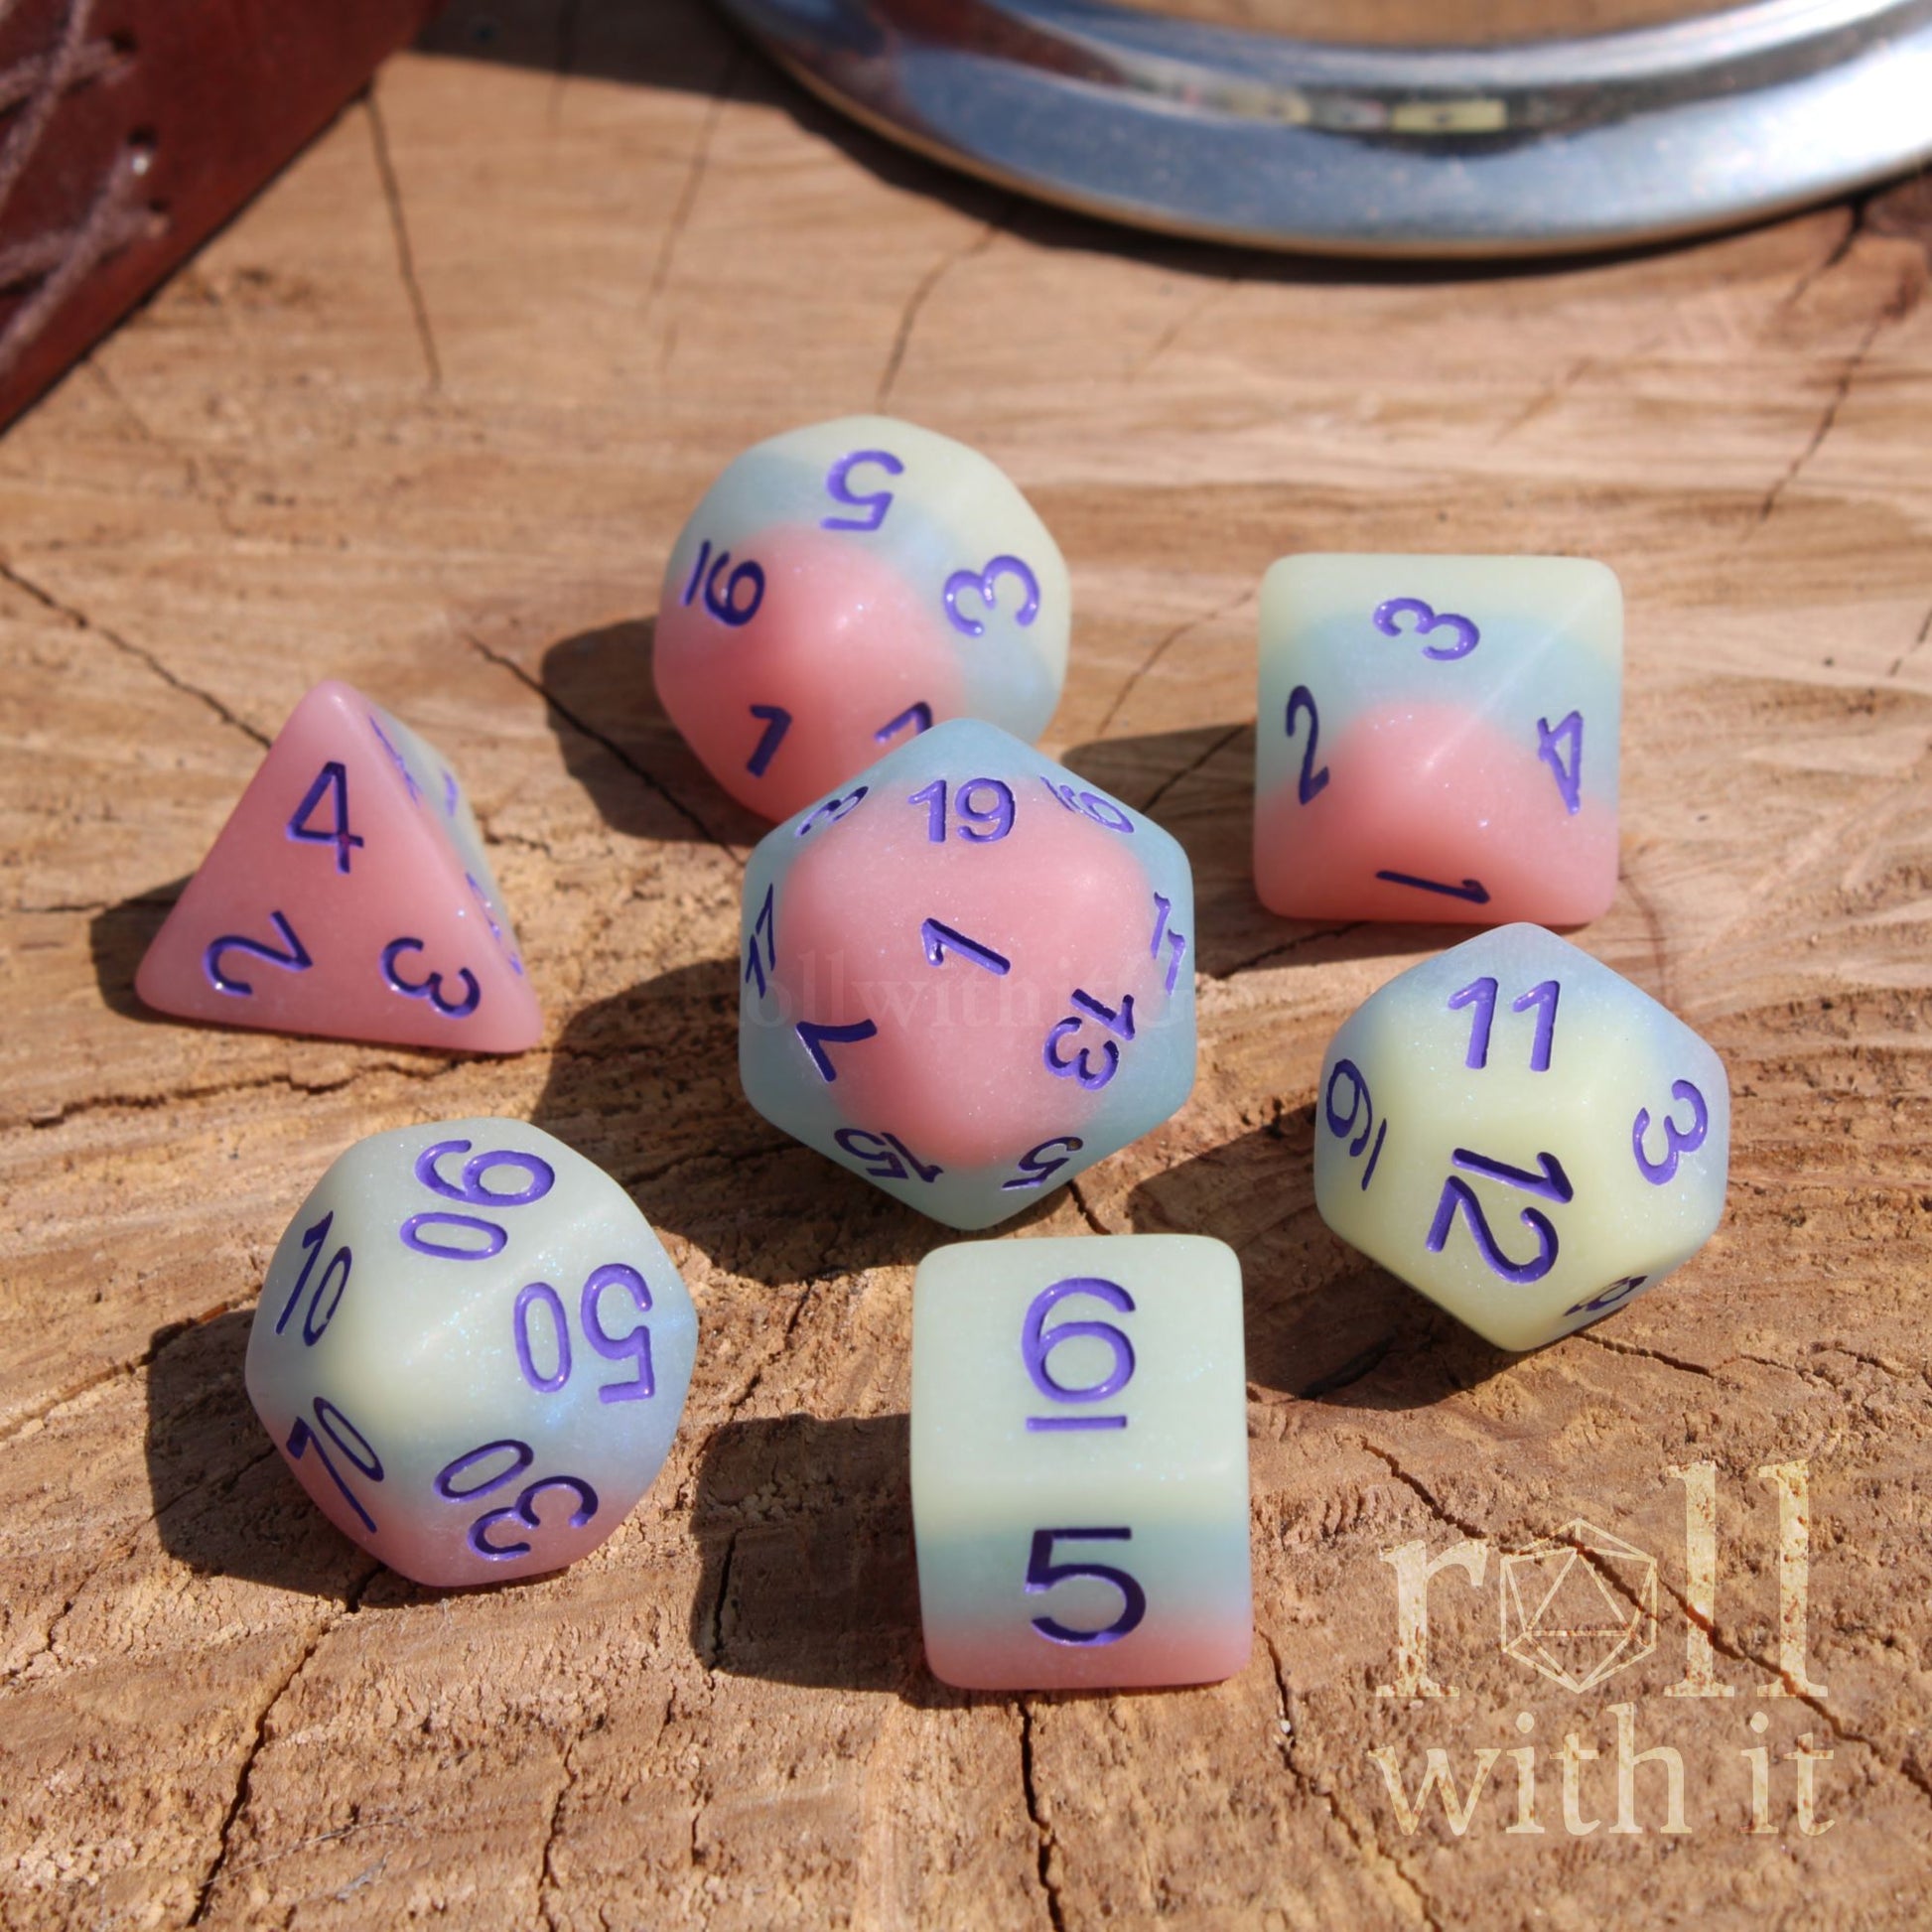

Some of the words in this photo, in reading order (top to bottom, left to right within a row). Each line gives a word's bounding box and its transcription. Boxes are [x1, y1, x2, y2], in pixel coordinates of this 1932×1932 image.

[820, 450, 904, 531] 5
[943, 555, 1039, 636] 3
[1373, 598, 1480, 660] 3
[1285, 685, 1329, 806] 2
[1537, 711, 1584, 815] 4
[286, 760, 364, 874] 4
[908, 777, 1016, 843] 19
[1375, 870, 1490, 904] 1
[203, 910, 313, 996] 2
[380, 937, 481, 1019] 3
[920, 918, 1011, 976] 1
[1043, 988, 1136, 1090] 13
[1448, 976, 1561, 1071] 11
[834, 1128, 944, 1183] 15
[1002, 1136, 1084, 1190] 5
[1633, 1079, 1708, 1185] 3
[1426, 1148, 1574, 1284] 12
[276, 1210, 351, 1346] 10
[514, 1263, 655, 1404] 50
[433, 1438, 599, 1562] 30
[1025, 1527, 1146, 1647] 5
